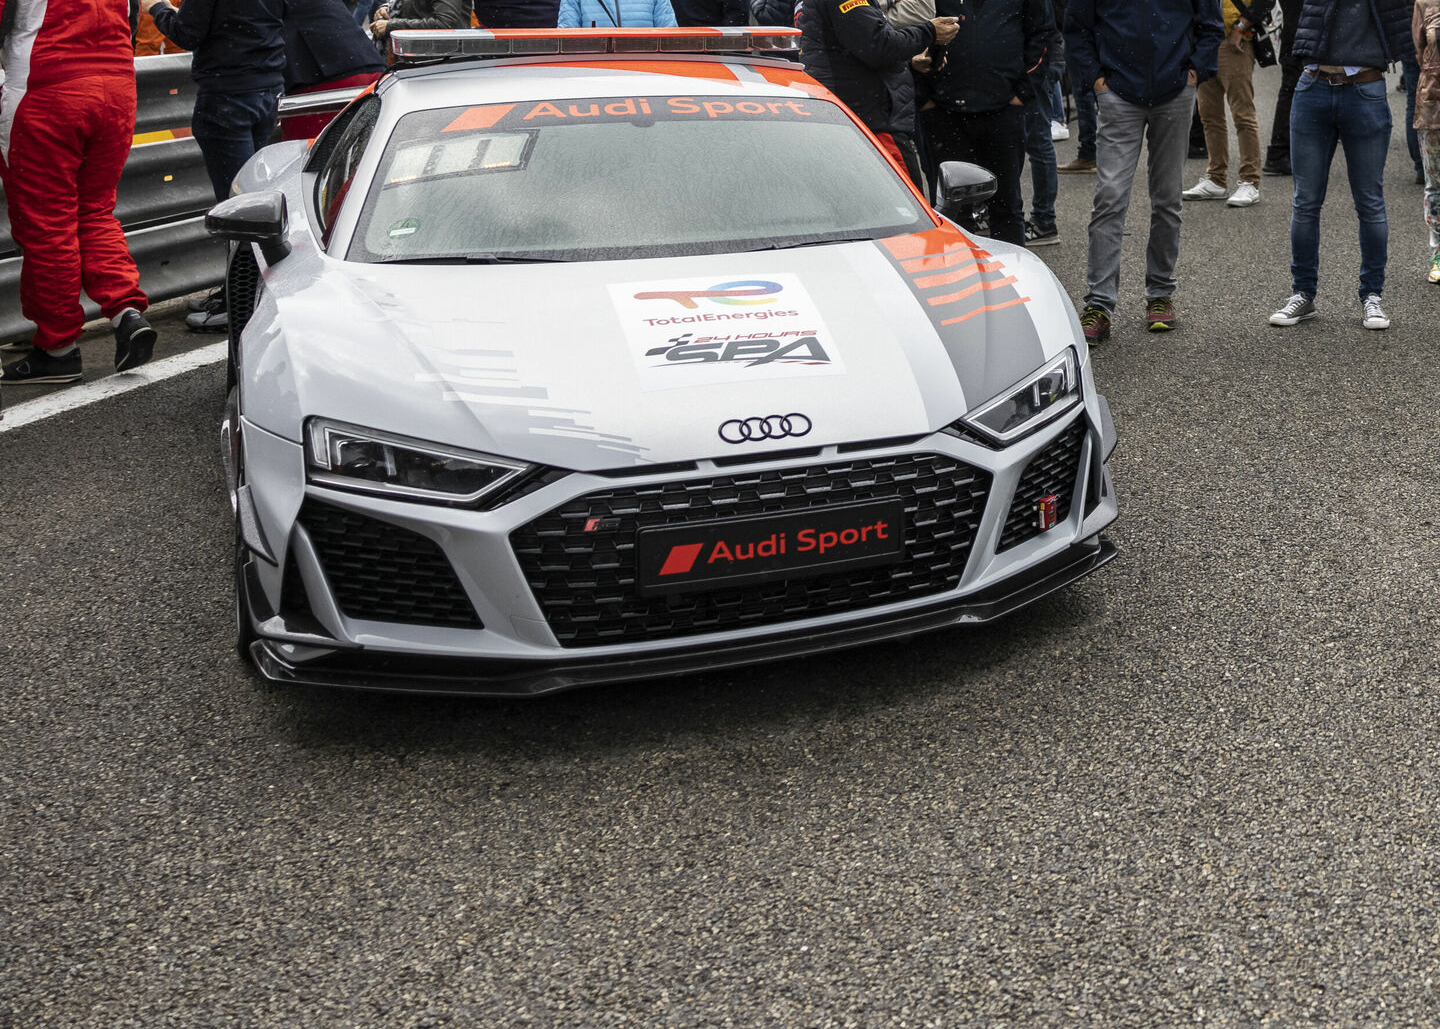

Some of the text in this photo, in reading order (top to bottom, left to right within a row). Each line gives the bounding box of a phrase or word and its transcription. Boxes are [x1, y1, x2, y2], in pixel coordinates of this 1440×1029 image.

[842, 0, 868, 13] PIRELLI
[523, 97, 812, 120] Audi Sport
[643, 308, 800, 327] TotalEnergies
[693, 330, 818, 344] 24 HOURS
[665, 336, 831, 368] SPA
[707, 521, 889, 564] Audi Sport
